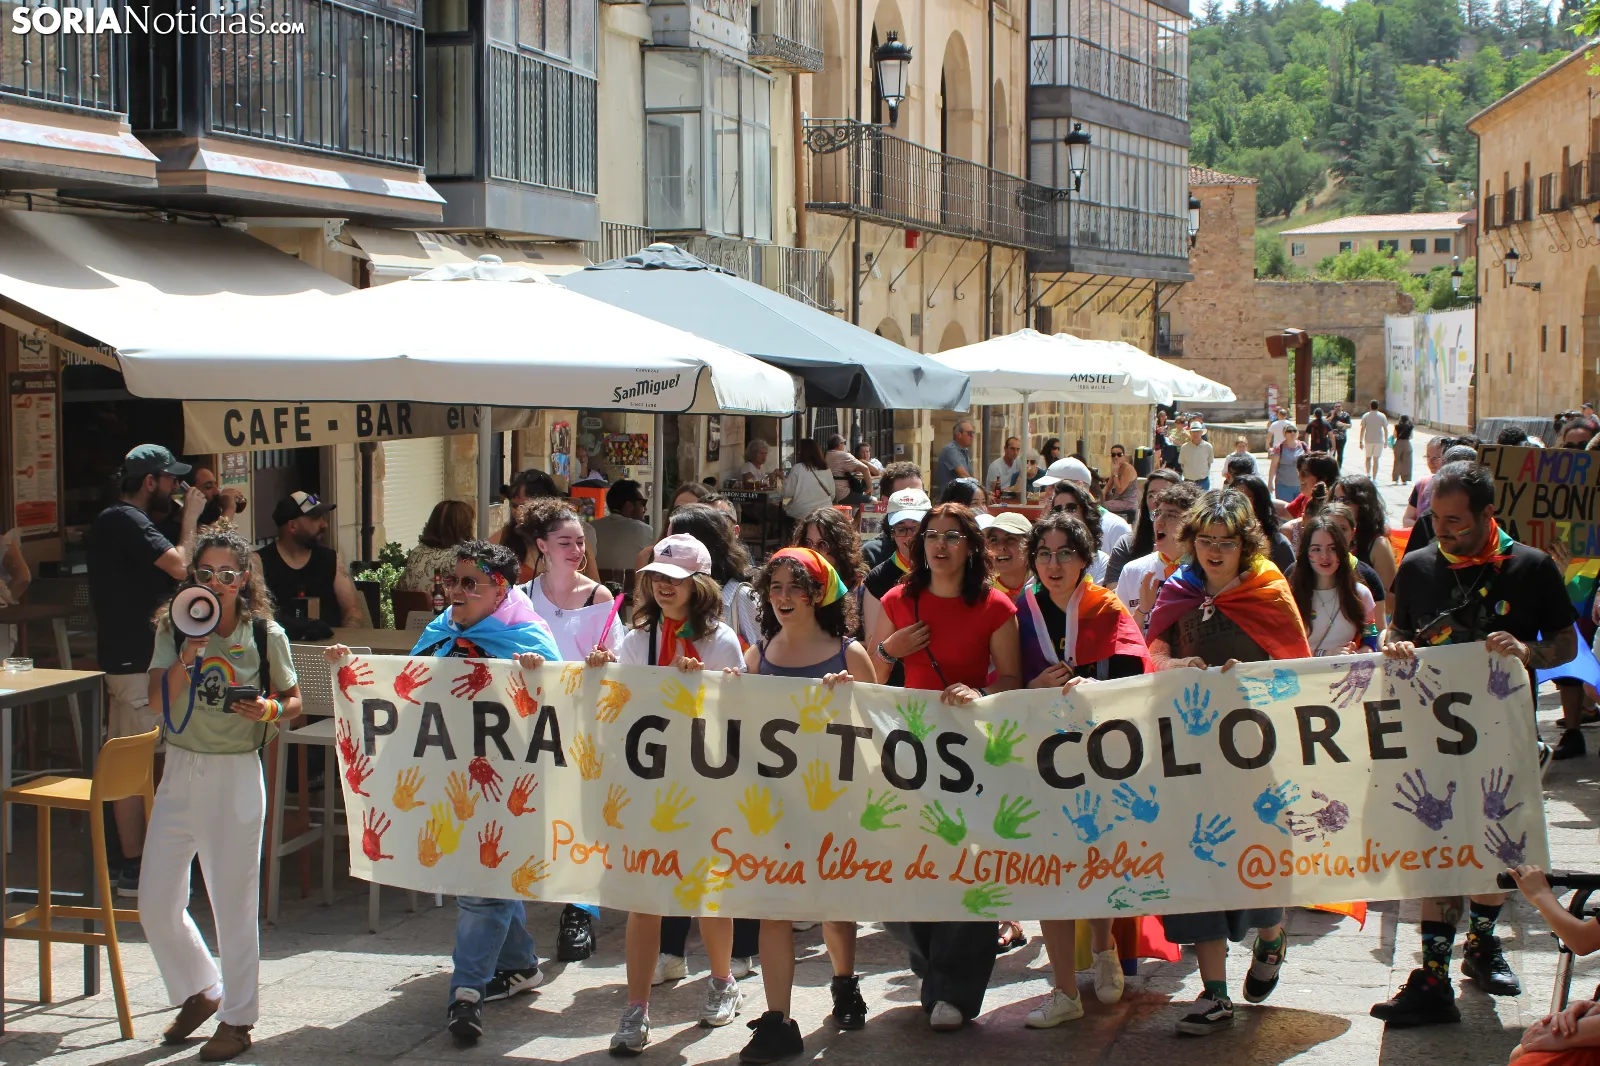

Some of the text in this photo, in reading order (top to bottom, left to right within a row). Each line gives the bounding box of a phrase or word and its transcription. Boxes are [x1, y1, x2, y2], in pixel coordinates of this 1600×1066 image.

[1070, 373, 1115, 384] AMSTEL
[355, 402, 413, 438] BAR
[1517, 450, 1592, 486] AMOR
[1532, 484, 1600, 520] BONI
[361, 698, 568, 768] PARA
[1036, 691, 1479, 790] COLORES
[551, 819, 613, 870] Por
[622, 844, 685, 881] una
[710, 827, 807, 886] Soria
[817, 831, 893, 884] libre
[903, 843, 939, 882] de
